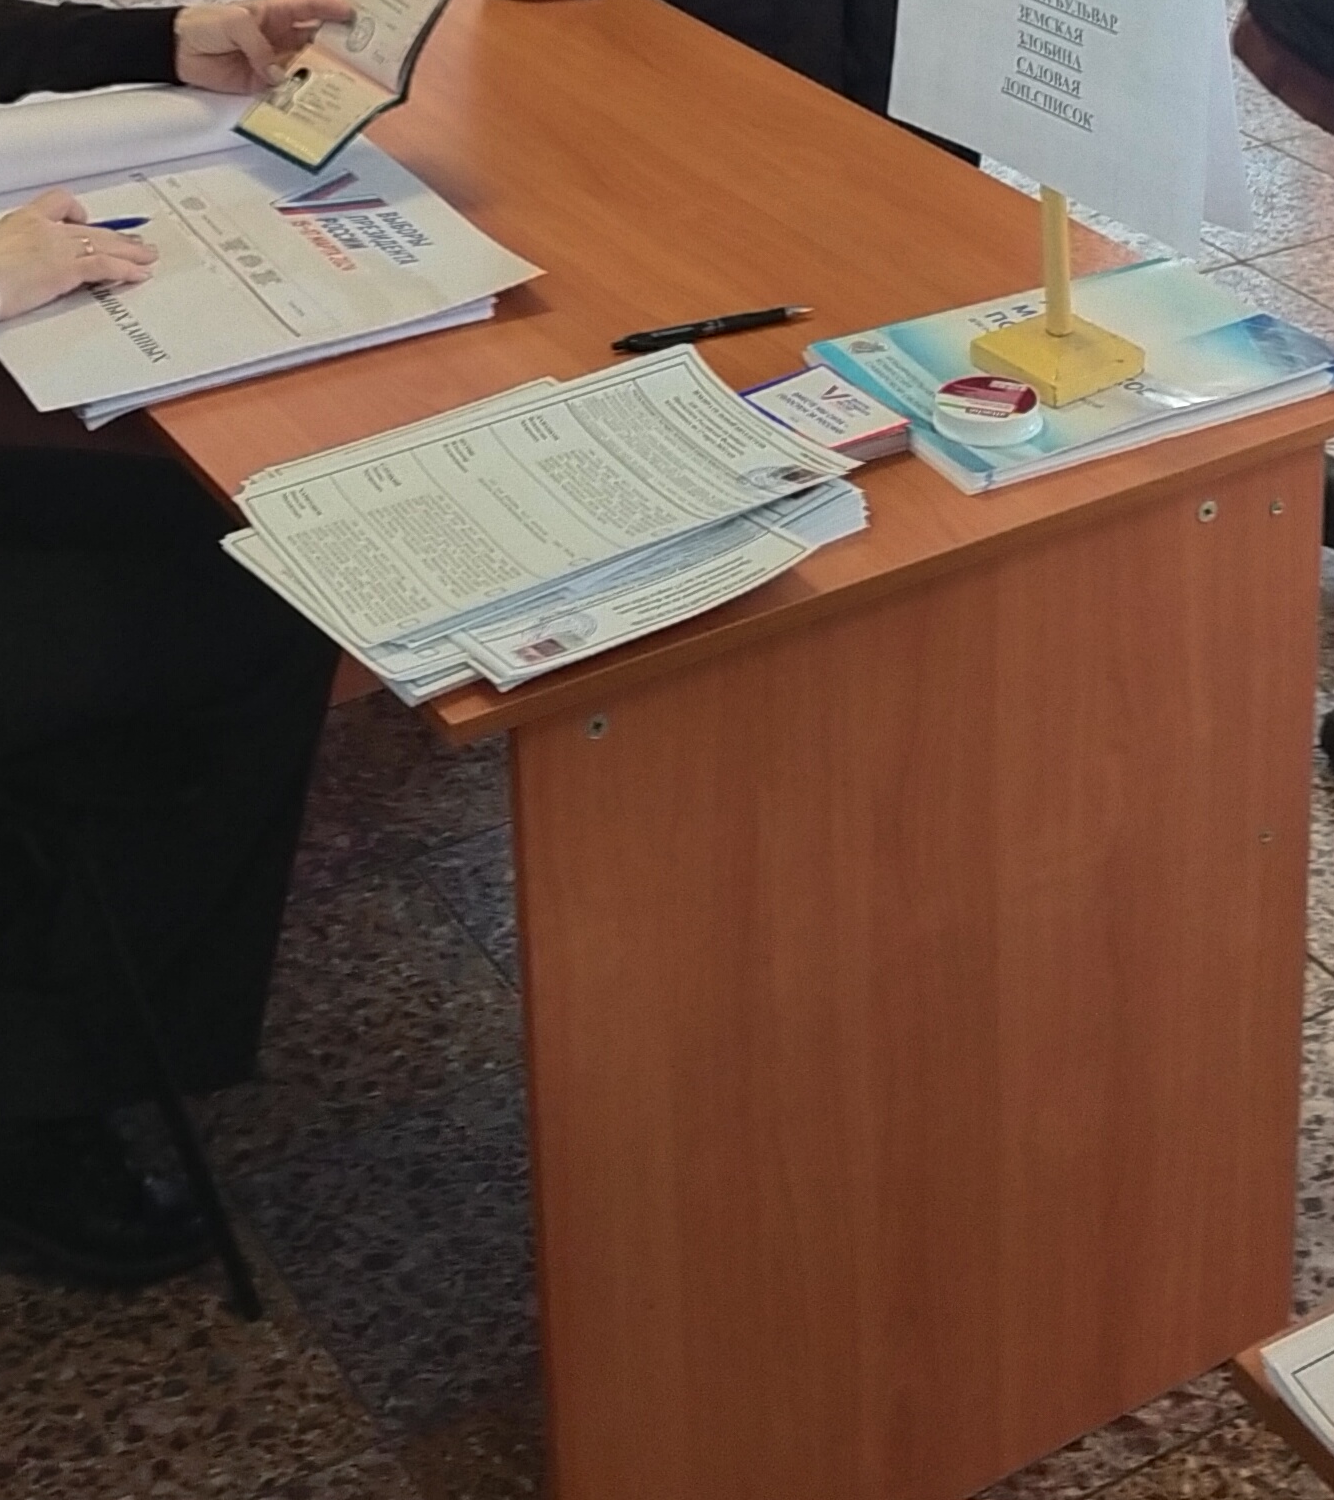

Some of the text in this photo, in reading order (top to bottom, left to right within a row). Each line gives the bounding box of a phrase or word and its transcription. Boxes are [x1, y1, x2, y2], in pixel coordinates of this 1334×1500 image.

[1018, 4, 1084, 46] ЗЕМСКАЯ
[1018, 30, 1083, 73] ЗЛОБИНА
[1016, 56, 1081, 99] САДОВАЯ
[315, 217, 369, 249] РОССИИ
[344, 215, 419, 265] ПРЕЗИДЕНТА
[376, 211, 434, 247] ВЫБОРЫ
